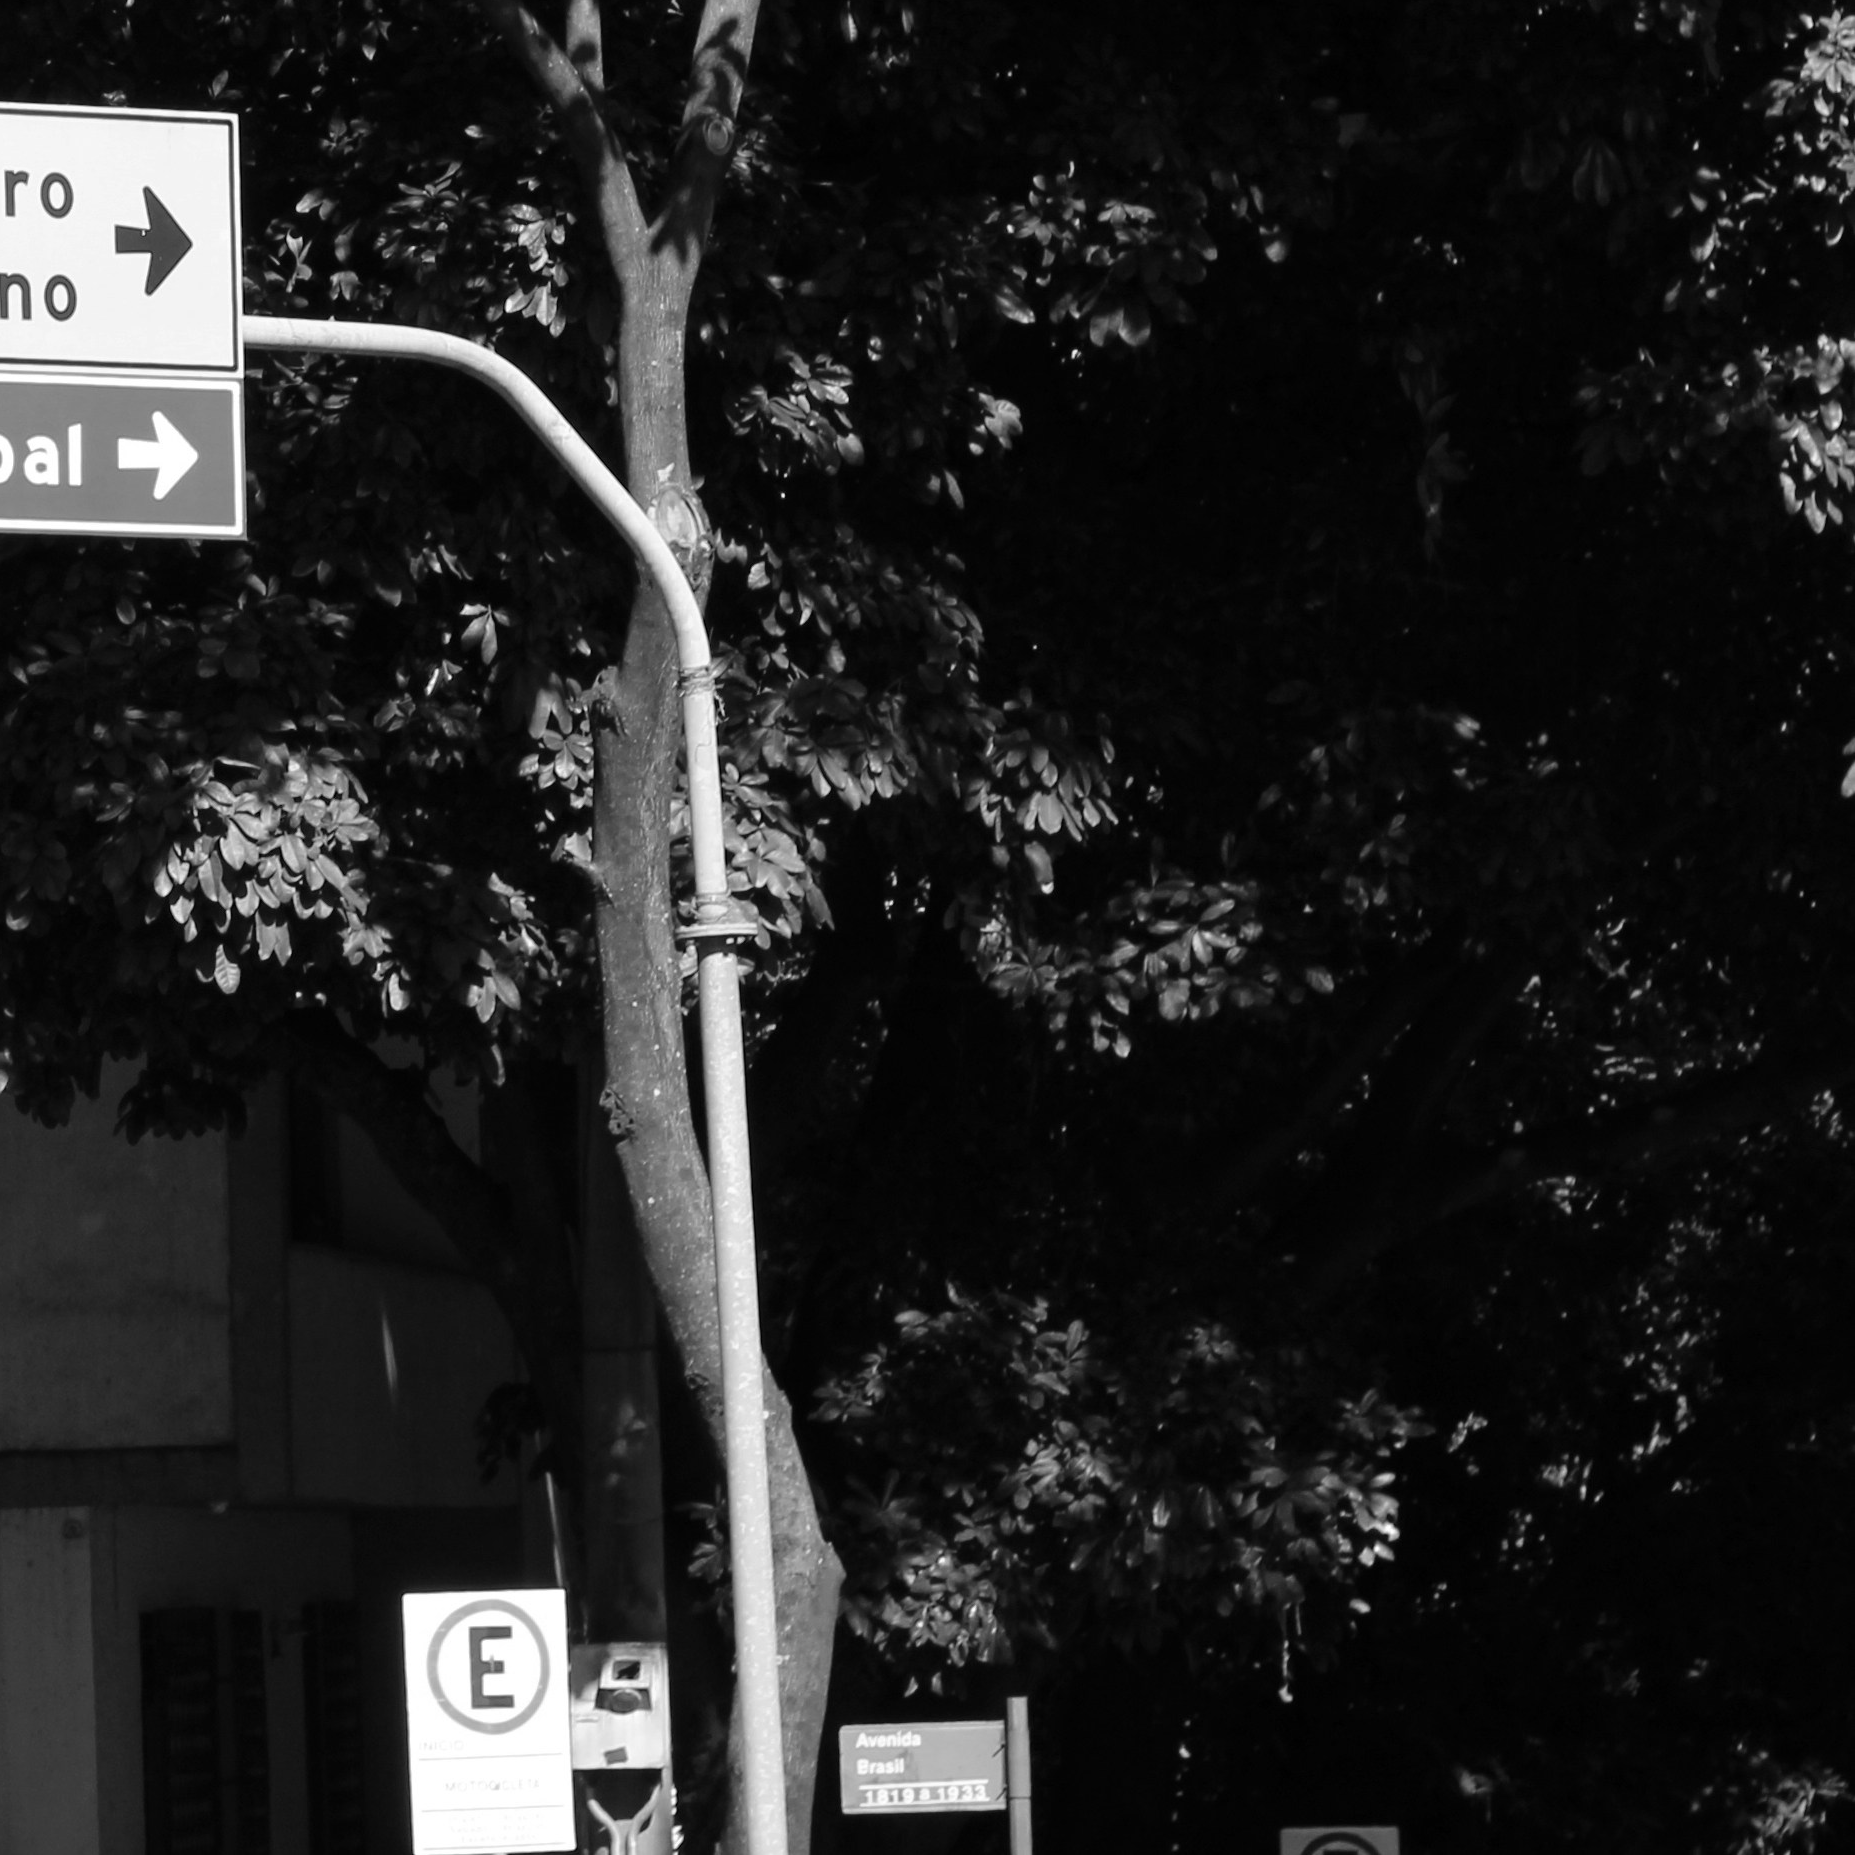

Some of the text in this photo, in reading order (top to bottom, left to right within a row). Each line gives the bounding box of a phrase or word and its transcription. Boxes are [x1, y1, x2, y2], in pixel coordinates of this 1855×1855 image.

[469, 1626, 515, 1709] E
[856, 1730, 922, 1748] Avenida
[856, 1758, 905, 1775] Brasil
[865, 1784, 987, 1805] 1819 a 1933
